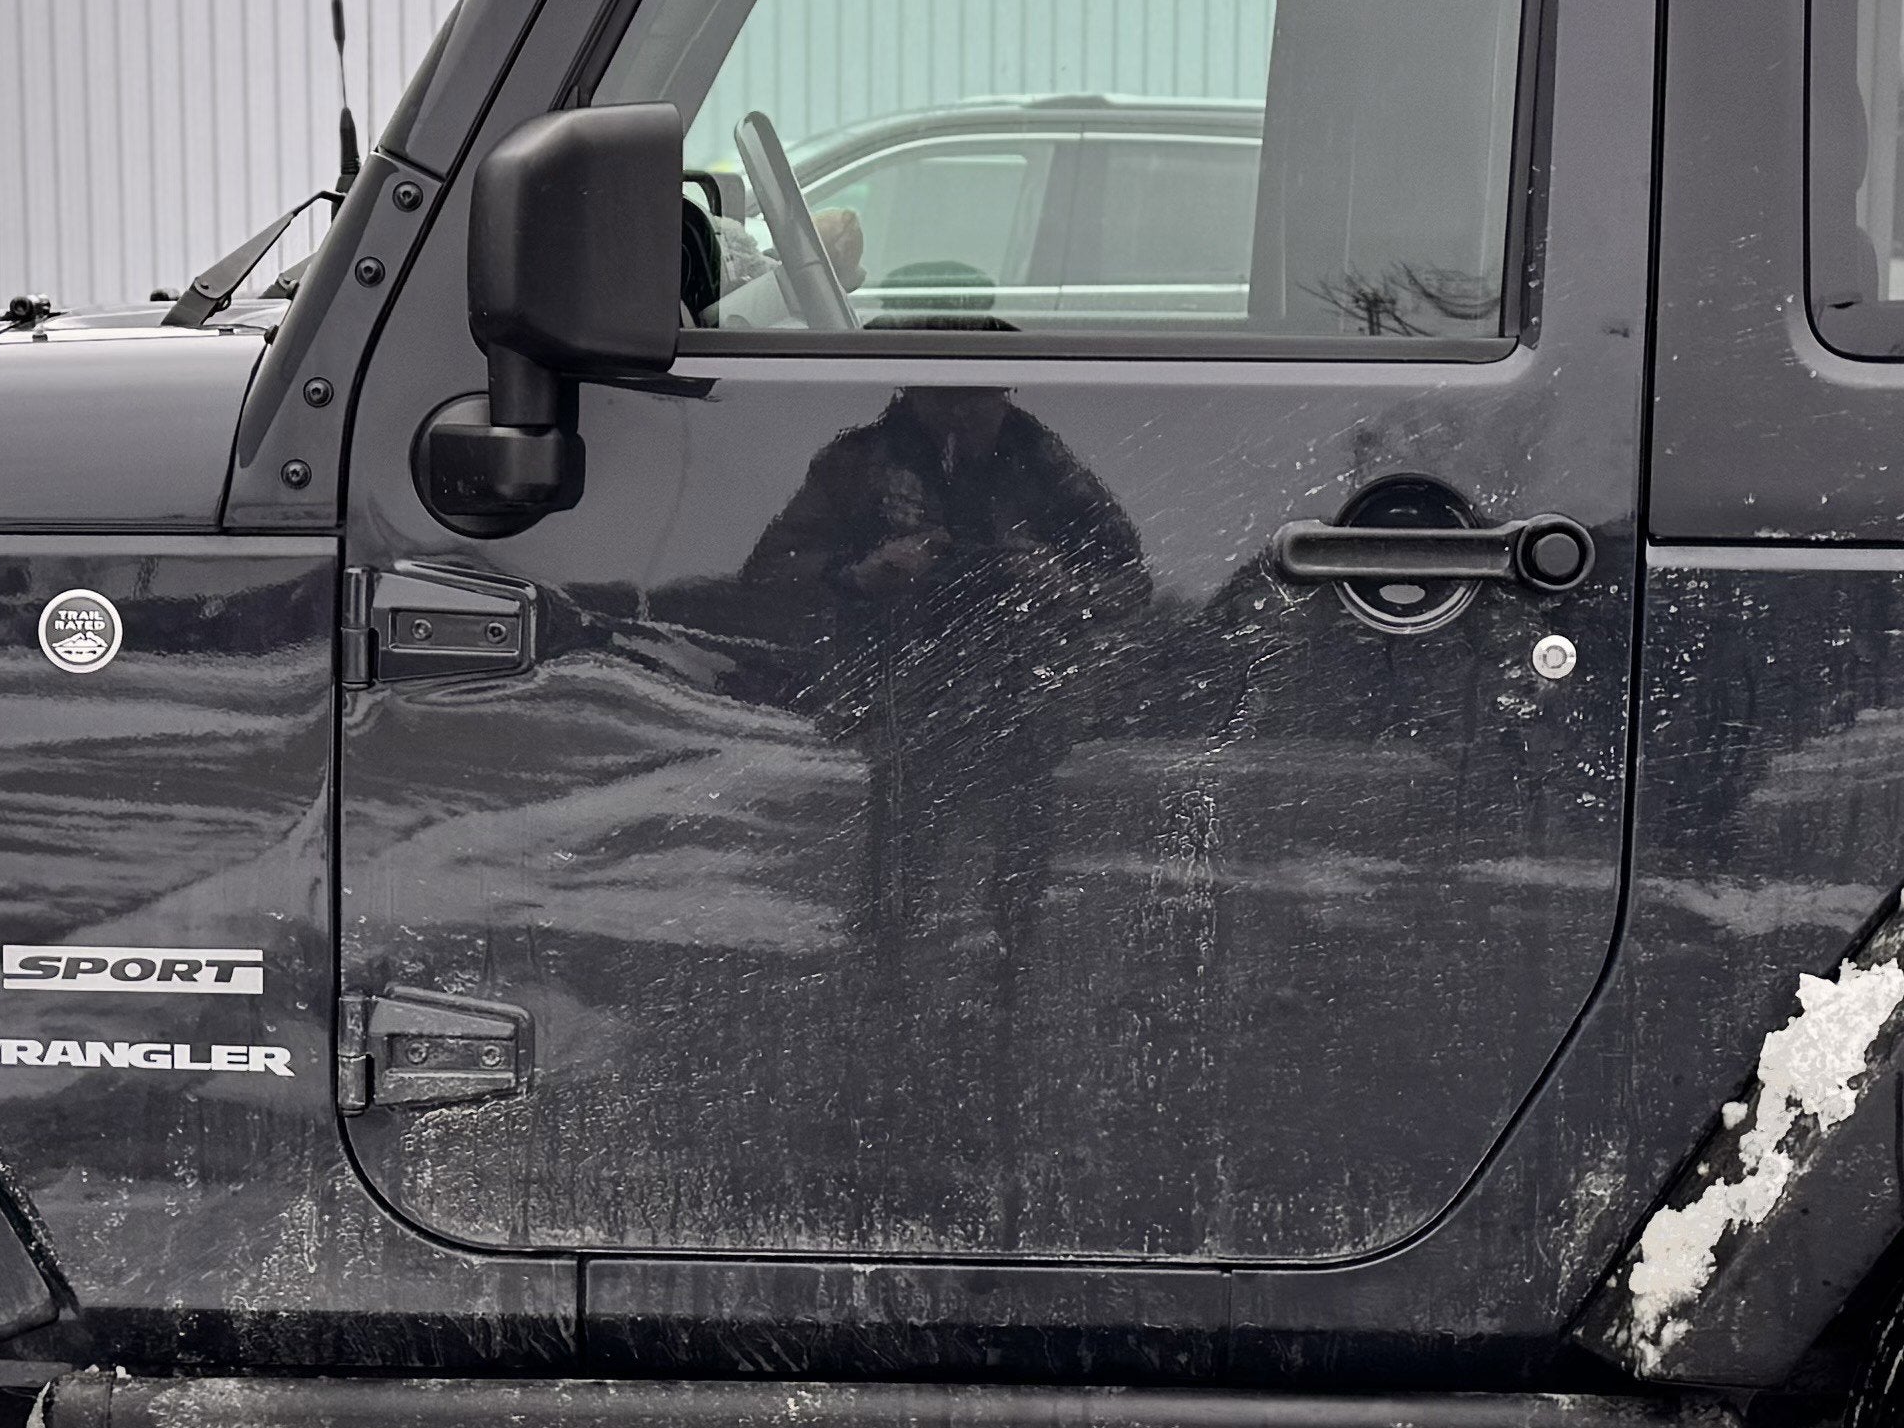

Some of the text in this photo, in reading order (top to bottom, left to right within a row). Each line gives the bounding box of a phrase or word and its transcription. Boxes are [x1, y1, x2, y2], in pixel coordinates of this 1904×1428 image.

[58, 610, 104, 621] TRAIL
[54, 620, 106, 631] RATED
[17, 955, 264, 984] SPORT
